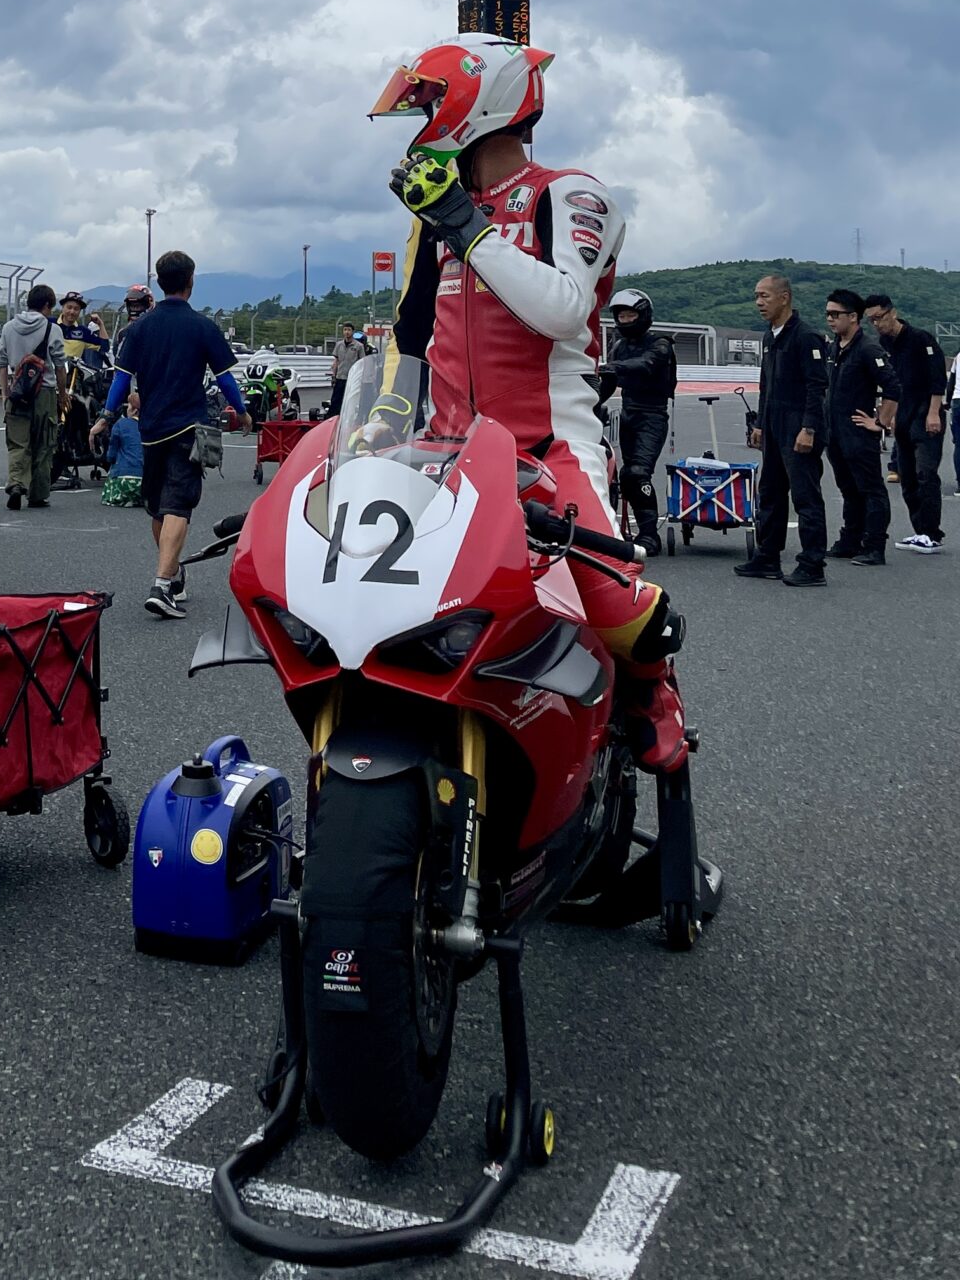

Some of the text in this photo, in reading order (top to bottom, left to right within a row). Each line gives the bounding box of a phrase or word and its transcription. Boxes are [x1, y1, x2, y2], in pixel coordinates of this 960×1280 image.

[496, 0, 528, 12] 1 2
[495, 11, 529, 22] 2 29
[495, 21, 529, 33] 3 56
[514, 33, 528, 43] 14
[469, 62, 485, 75] agv
[508, 199, 527, 212] ag
[574, 232, 600, 248] DUCATI
[248, 365, 263, 376] 70
[322, 500, 420, 585] 12
[436, 597, 462, 612] UCATI
[462, 797, 475, 876] PIRELLI
[323, 982, 361, 992] SUPREMA
